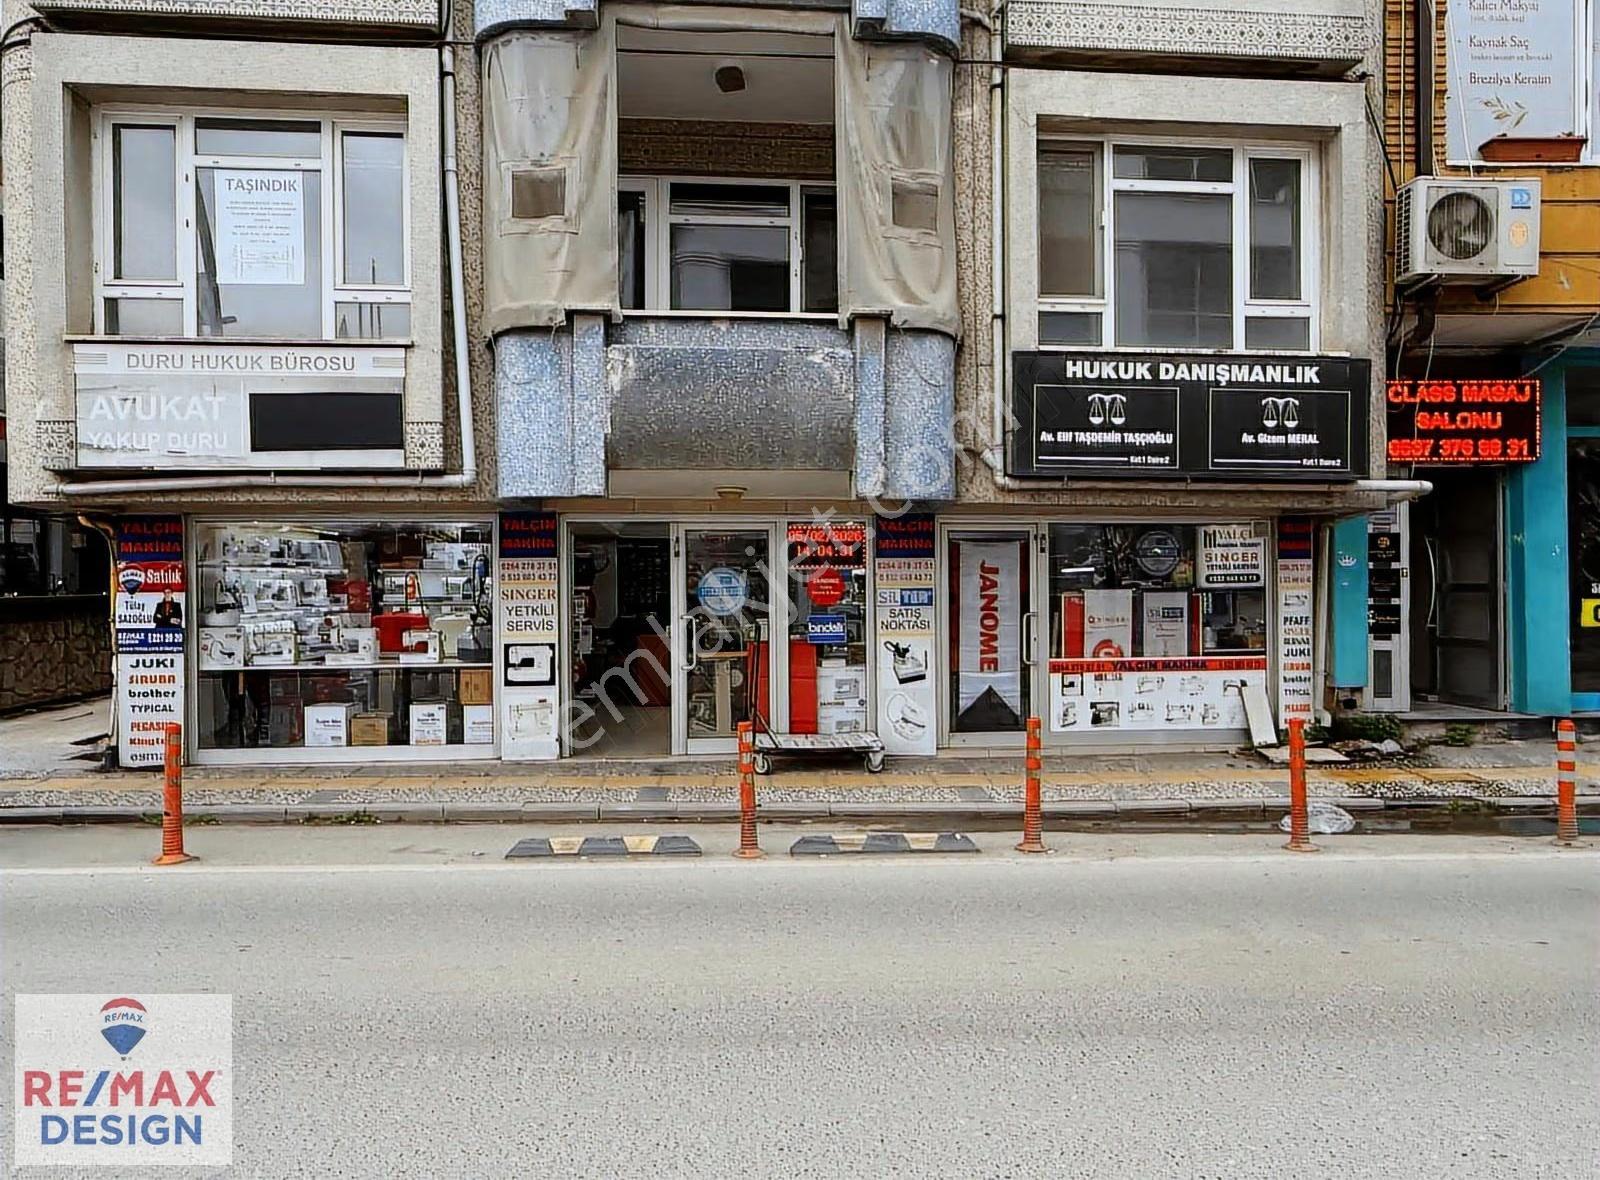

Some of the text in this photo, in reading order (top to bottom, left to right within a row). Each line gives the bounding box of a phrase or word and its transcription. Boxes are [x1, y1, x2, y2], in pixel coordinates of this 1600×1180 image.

[1469, 35, 1507, 49] Kaynak
[226, 178, 297, 194] TAŞINDIK
[127, 352, 356, 371] DURU HUKUK BÜROSU
[1065, 360, 1320, 385] HUKUK DANIŞMANLIK
[1388, 385, 1531, 402] CLASS MASAJ
[89, 396, 226, 420] AVUKAT
[1416, 412, 1502, 429] SALONU
[89, 432, 228, 449] YAKUP DURU
[1040, 431, 1055, 442] Av.
[1074, 430, 1121, 445] TAŞDEMİR
[1242, 432, 1256, 443] Av.
[1288, 434, 1320, 444] MERAL
[788, 530, 862, 542] 05/02/2026
[797, 545, 853, 557] 14:04:31
[1204, 552, 1258, 562] SINGER
[146, 568, 182, 584] Satılık
[502, 588, 556, 600] SINGER
[506, 603, 554, 616] YETKİLİ
[889, 608, 922, 620] SATIŞ
[979, 560, 1000, 672] JANOME
[506, 618, 554, 632] SERVİS
[880, 620, 930, 630] NOKTASI
[1283, 616, 1311, 626] PFAFF
[1284, 648, 1311, 657] JUKI
[130, 658, 174, 668] JUKI
[128, 689, 176, 698] brother
